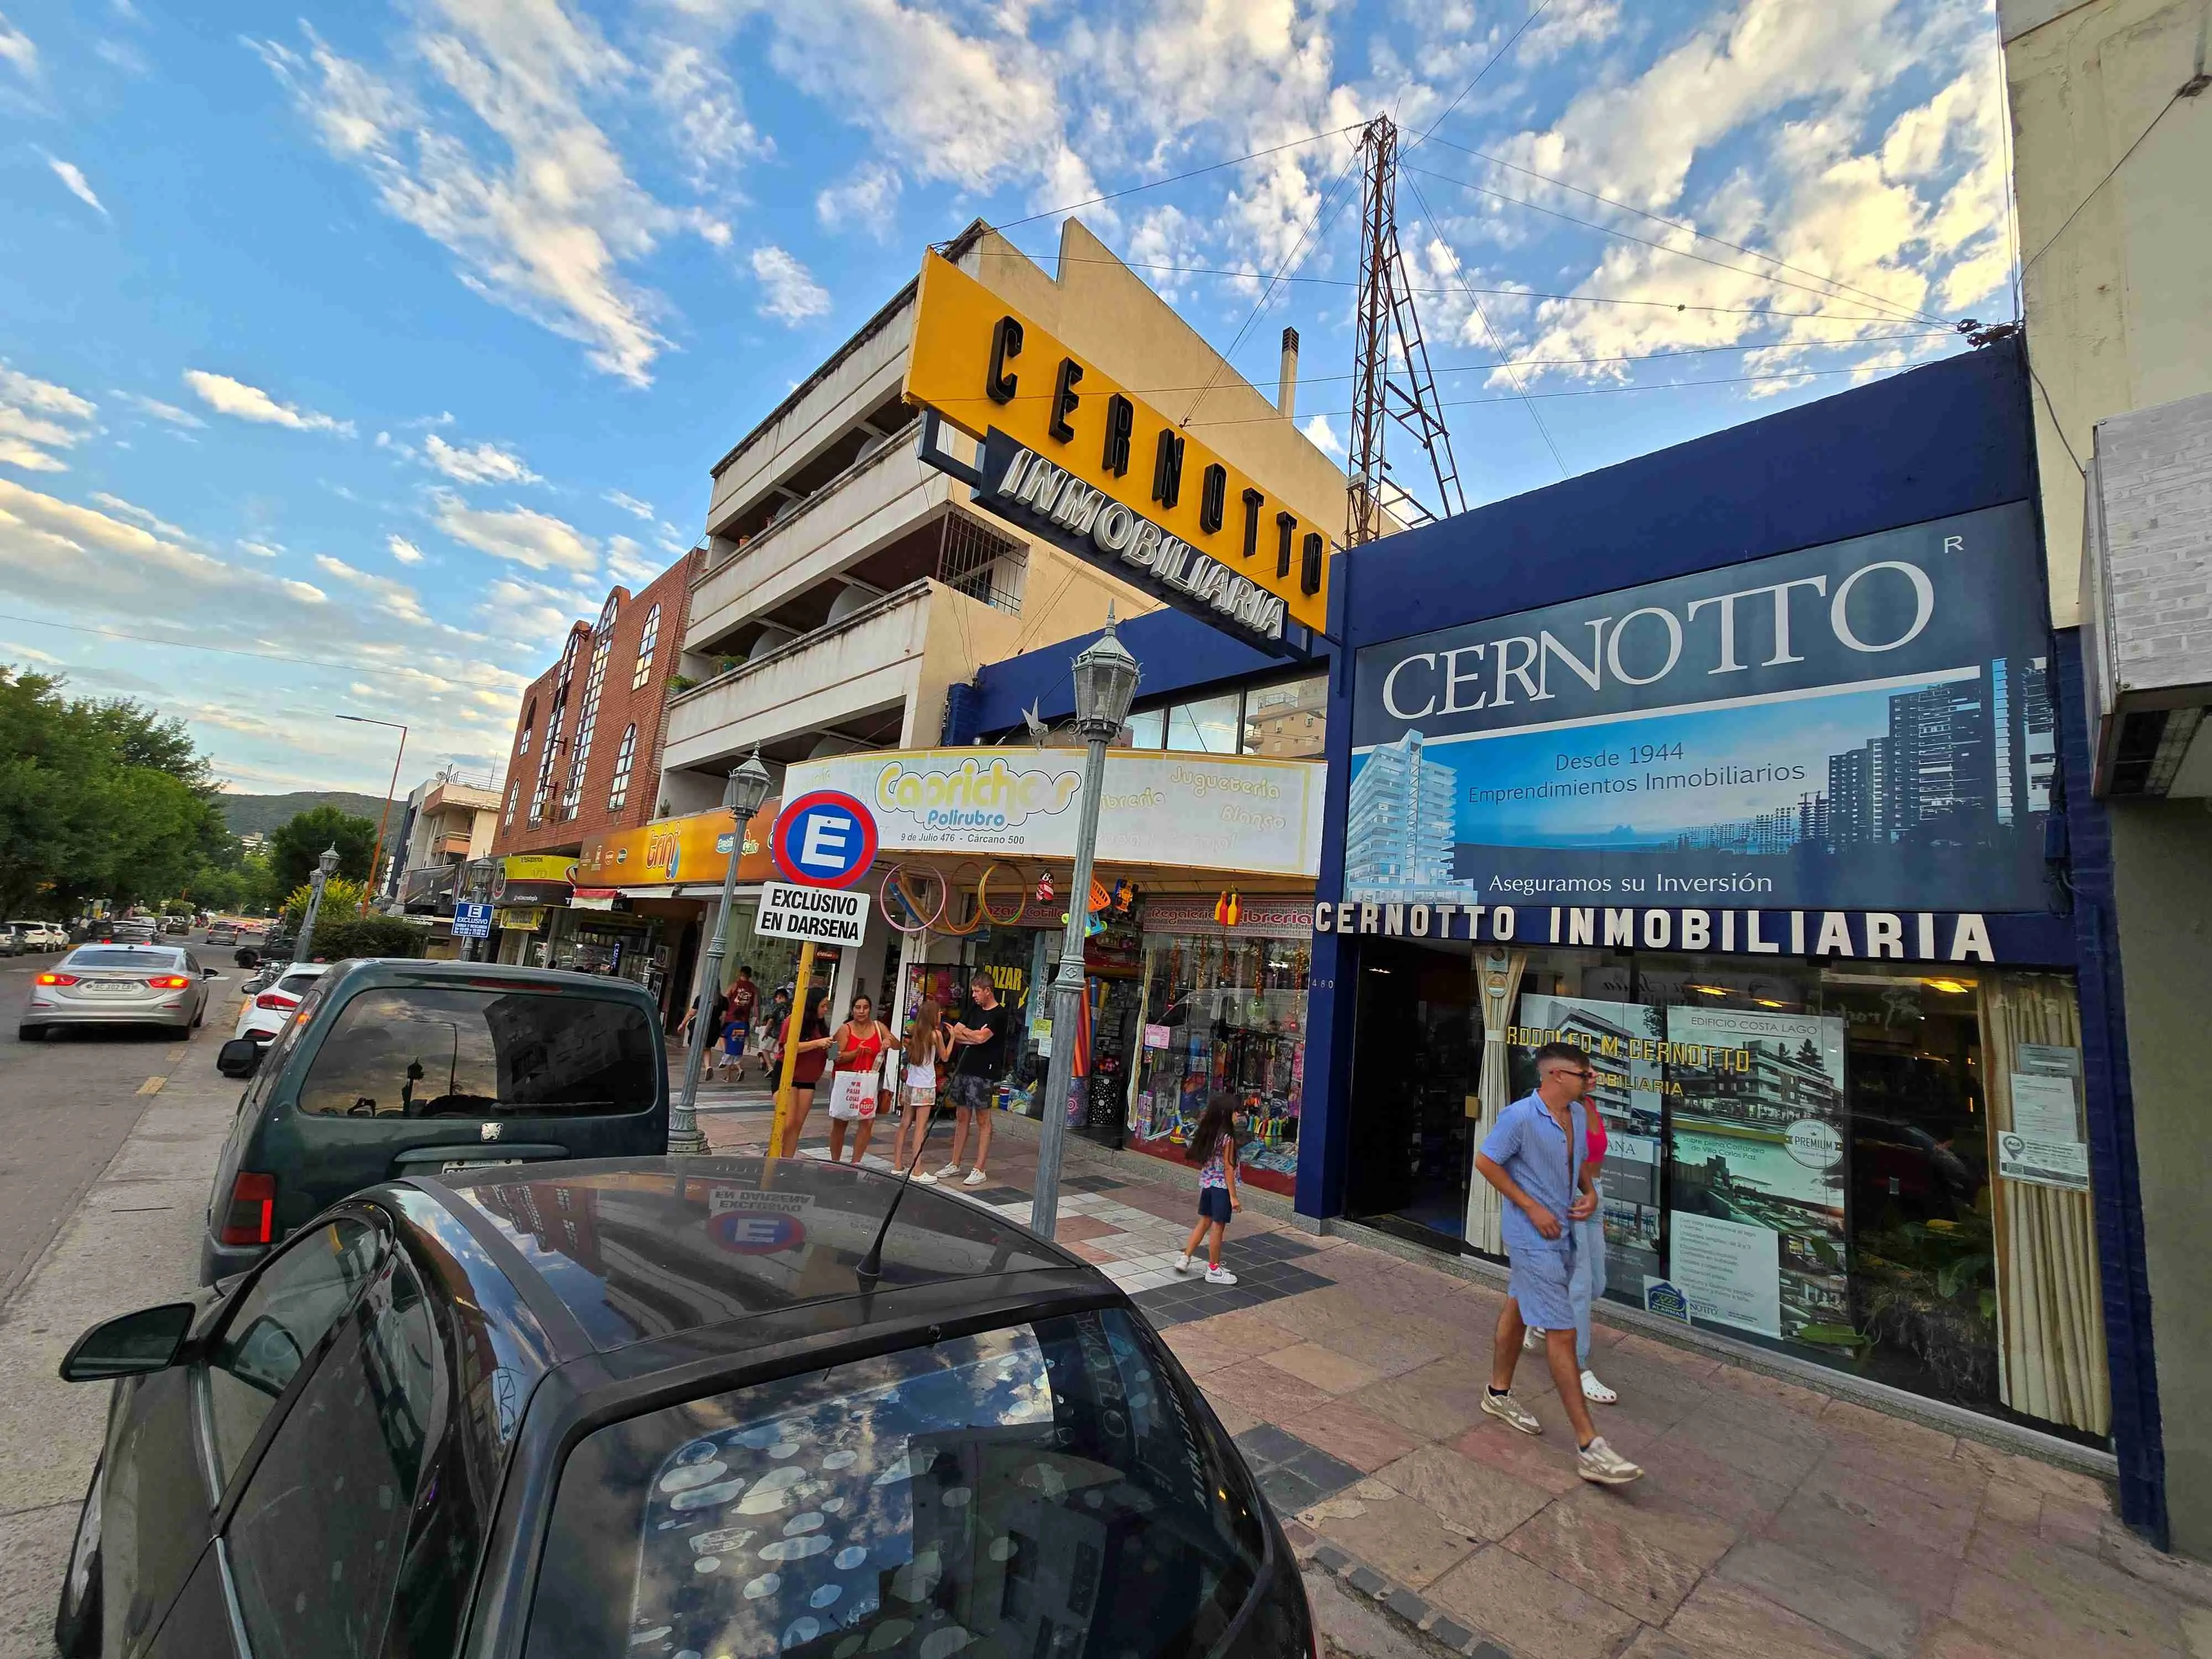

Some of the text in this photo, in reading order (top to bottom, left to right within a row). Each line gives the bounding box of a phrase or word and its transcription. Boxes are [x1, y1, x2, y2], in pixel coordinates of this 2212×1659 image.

[985, 315, 1323, 595] CERNOTTO
[997, 447, 1285, 640] INMOBILIARIA
[1382, 560, 1935, 721] CERNOTTO
[1555, 741, 1684, 771] Desde 1944
[1468, 759, 1805, 805] Emprendimientos Inmobiliarios
[928, 810, 1005, 827] Polirubro
[801, 814, 851, 869] E
[907, 833, 917, 842] de
[919, 833, 938, 842] Julio
[940, 833, 955, 842] 476
[1008, 835, 1025, 845] 500
[1489, 871, 1772, 898] Aseguramos su Inversión
[771, 889, 858, 916] EXCLUSIVO
[761, 911, 858, 940] EN DARSENA
[1240, 909, 1313, 925] ibreria
[1315, 902, 1995, 962] CERNOTTO INMOBILIARIA
[1690, 1016, 1818, 1035] EDIFICIO COSTA LAGO
[1601, 1036, 1623, 1058] M.
[1629, 1037, 1750, 1072] CERNOTTO
[1703, 1146, 1717, 1156] Villa
[1718, 1149, 1742, 1159] Carlos
[1794, 1136, 1833, 1150] PREMIUM
[1652, 1305, 1685, 1318] ALARMAS
